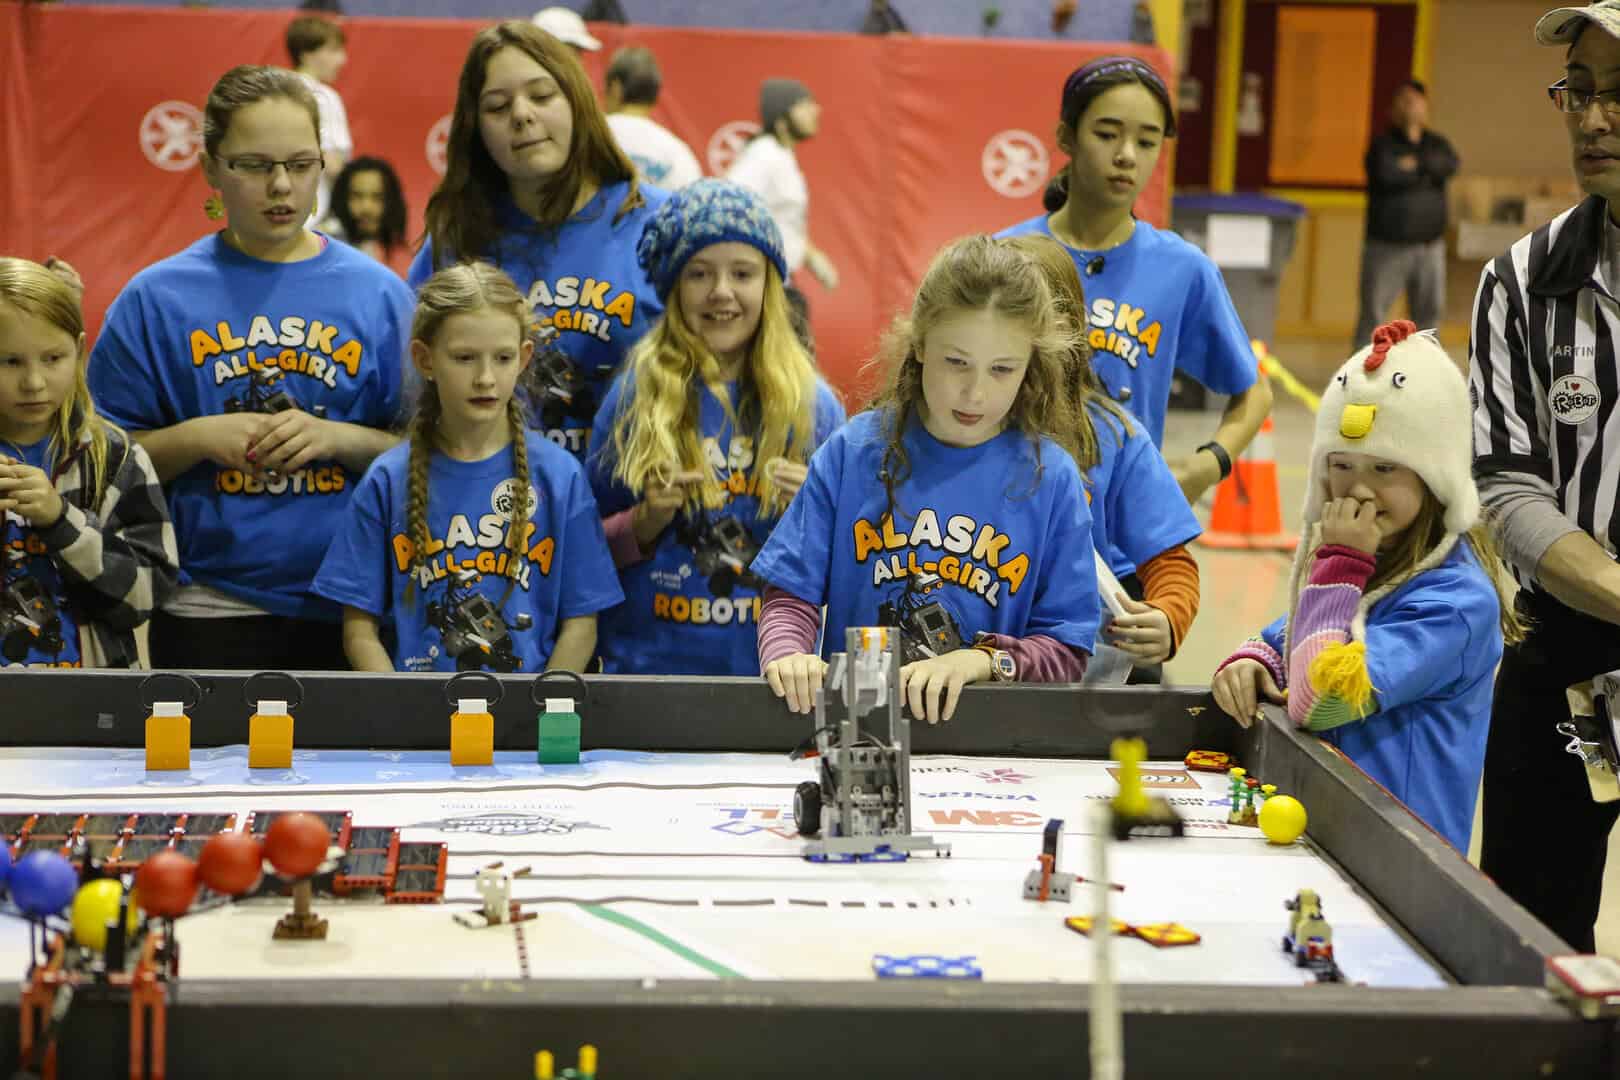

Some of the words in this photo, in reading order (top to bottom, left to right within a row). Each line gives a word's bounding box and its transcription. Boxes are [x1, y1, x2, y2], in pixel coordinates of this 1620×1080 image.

[527, 276, 636, 328] ASKA
[189, 315, 364, 377] ALASKA
[1084, 298, 1163, 358] SKA
[1087, 328, 1141, 369] GIRL
[213, 351, 337, 388] ALL-GIRL
[1550, 345, 1595, 356] ARTIN
[215, 467, 345, 495] OBOTICS
[852, 508, 1031, 596] ALASKA
[872, 551, 1000, 608] ALL-GIRL
[654, 593, 761, 624] ROBOTI
[928, 810, 1043, 826] 3M
